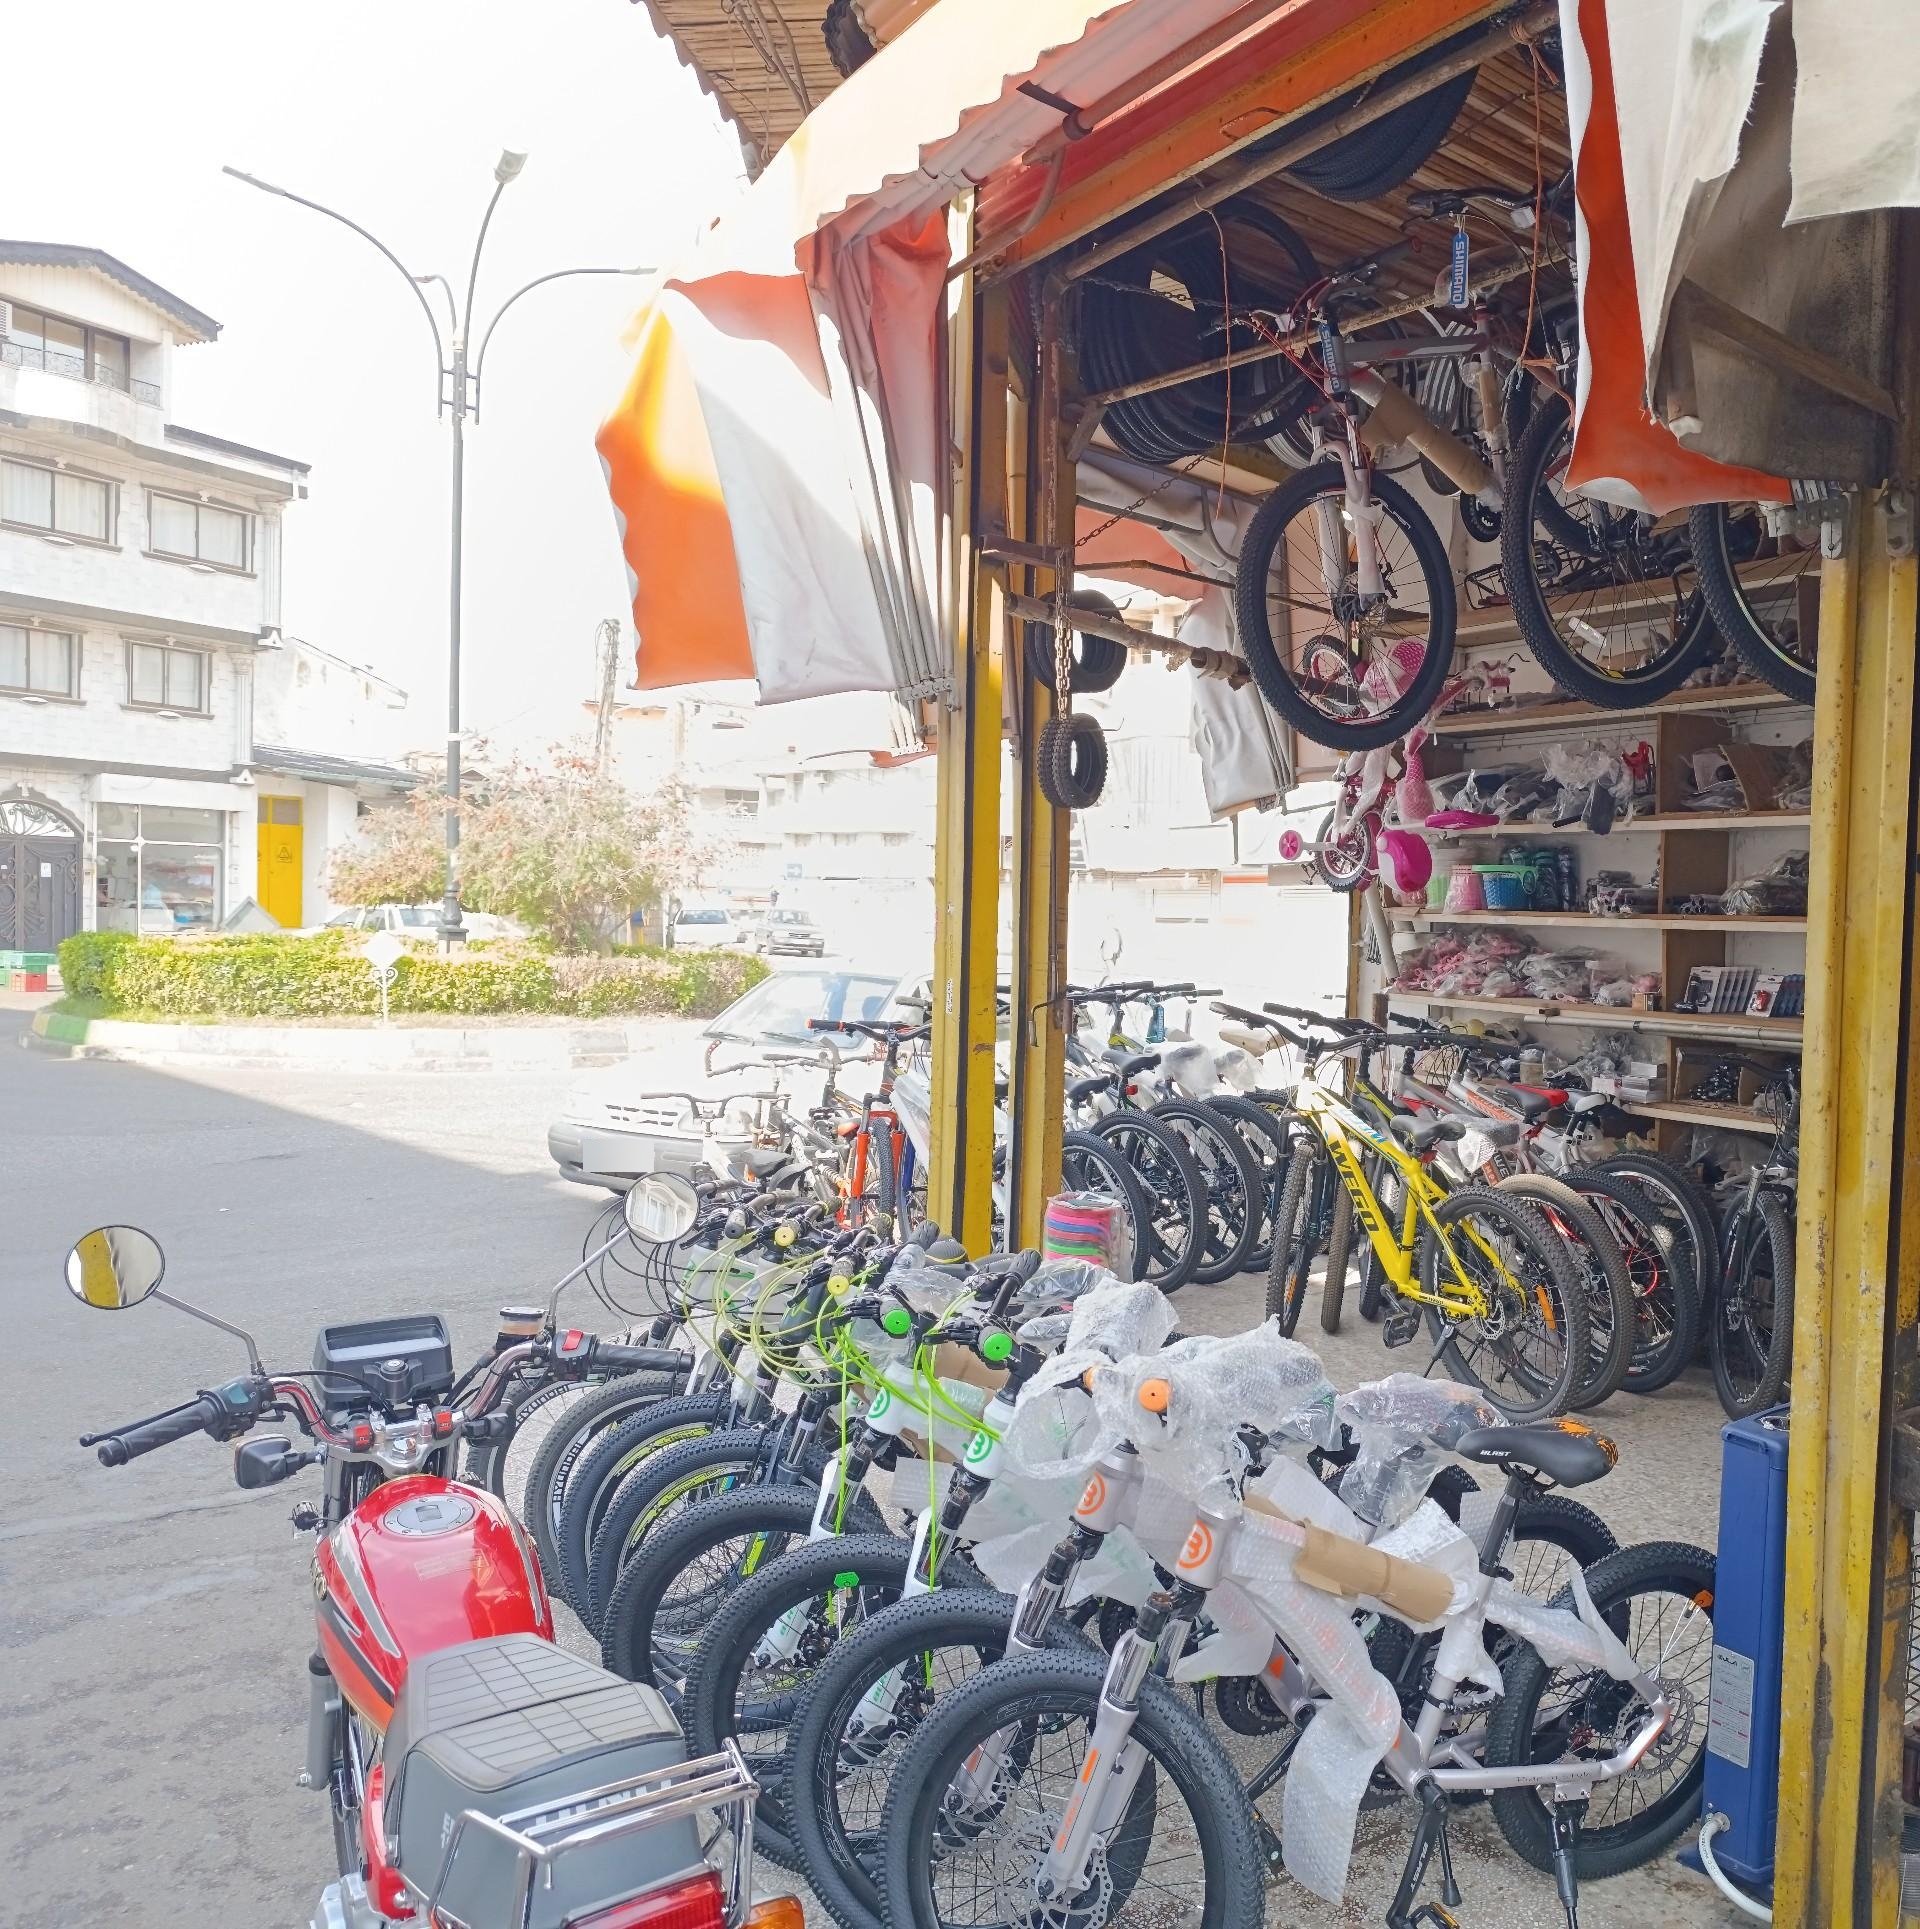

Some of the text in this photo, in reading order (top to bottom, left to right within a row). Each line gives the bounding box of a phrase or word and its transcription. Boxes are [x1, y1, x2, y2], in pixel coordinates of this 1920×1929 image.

[1452, 241, 1465, 303] SHIMANO
[1321, 330, 1340, 390] SHIMANO
[1328, 1139, 1379, 1232] WEGO
[516, 1385, 569, 1426] HYUNDAI
[553, 1442, 582, 1503] HYUNDAI
[1479, 1449, 1511, 1457] BLAST
[1410, 1841, 1429, 1893] BLAST
